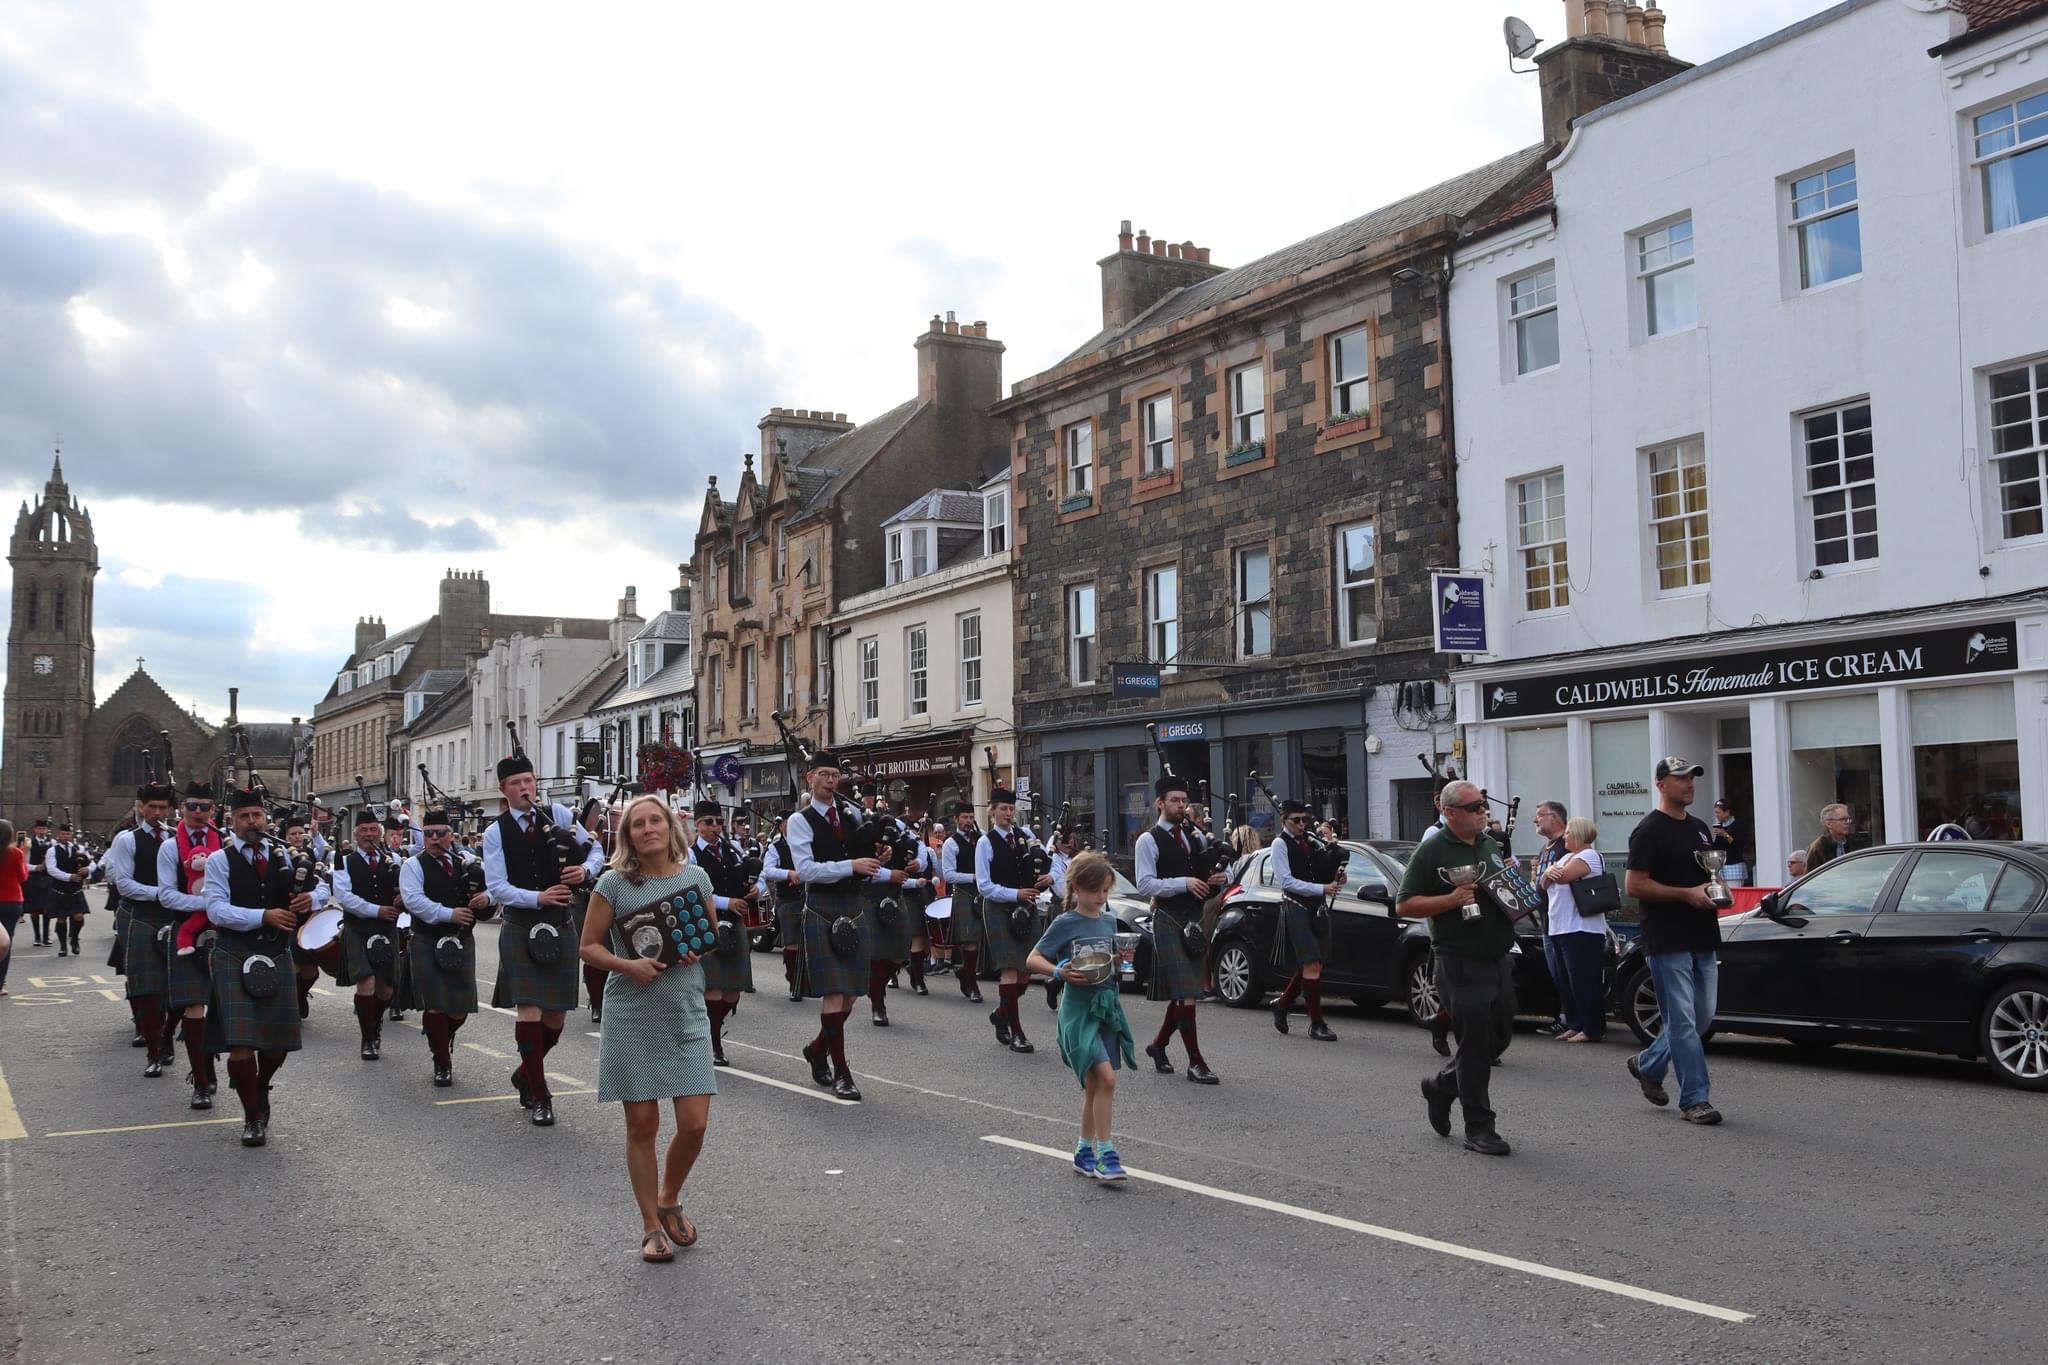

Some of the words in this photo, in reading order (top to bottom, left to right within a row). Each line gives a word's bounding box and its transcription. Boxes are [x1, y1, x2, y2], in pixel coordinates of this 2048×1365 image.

[1125, 676, 1157, 686] GREGGS
[1555, 674, 1680, 706] CALDWELLS
[1682, 663, 1774, 695] Homemade
[1777, 659, 1820, 684] ICE
[1825, 647, 1924, 679] CREAM
[1168, 723, 1203, 737] GREGGS
[888, 758, 930, 774] BROTHERS
[1606, 781, 1640, 790] CALDWELL'S
